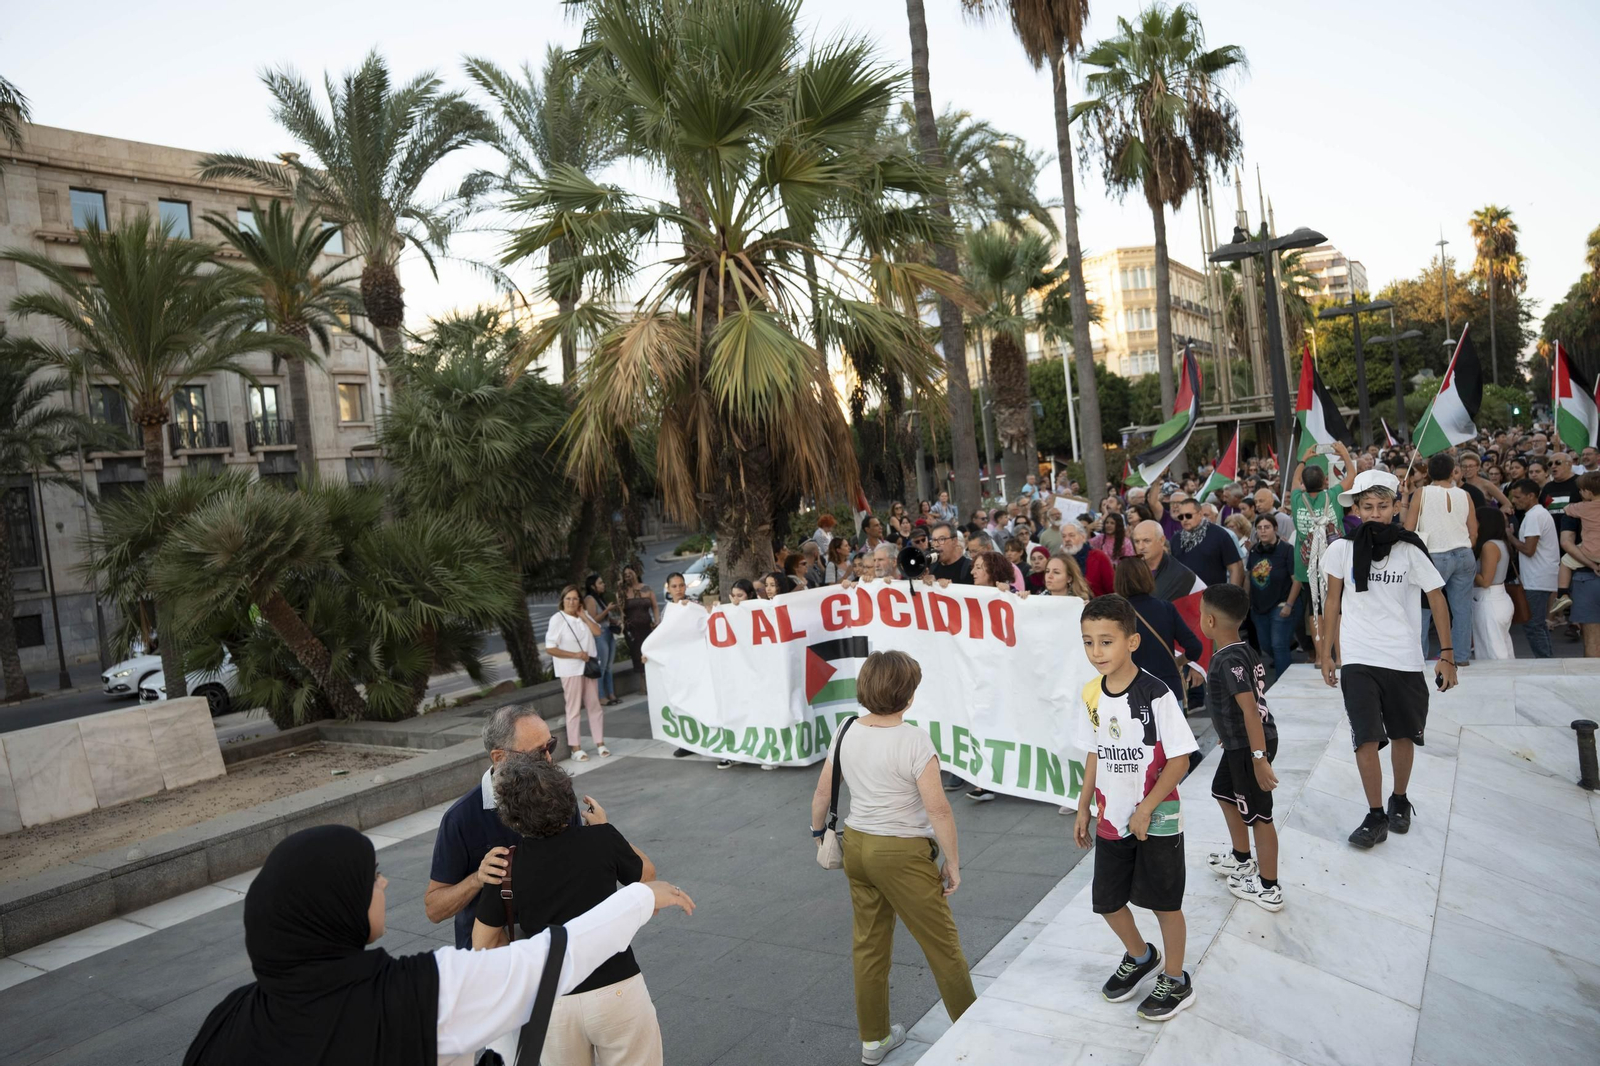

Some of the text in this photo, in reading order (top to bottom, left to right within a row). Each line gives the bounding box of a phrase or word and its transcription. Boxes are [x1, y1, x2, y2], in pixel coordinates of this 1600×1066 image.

[1368, 570, 1407, 585] ushin'
[707, 611, 737, 648] O
[752, 604, 807, 645] AL
[1097, 744, 1144, 761] Emirates
[1114, 763, 1139, 773] BETTER
